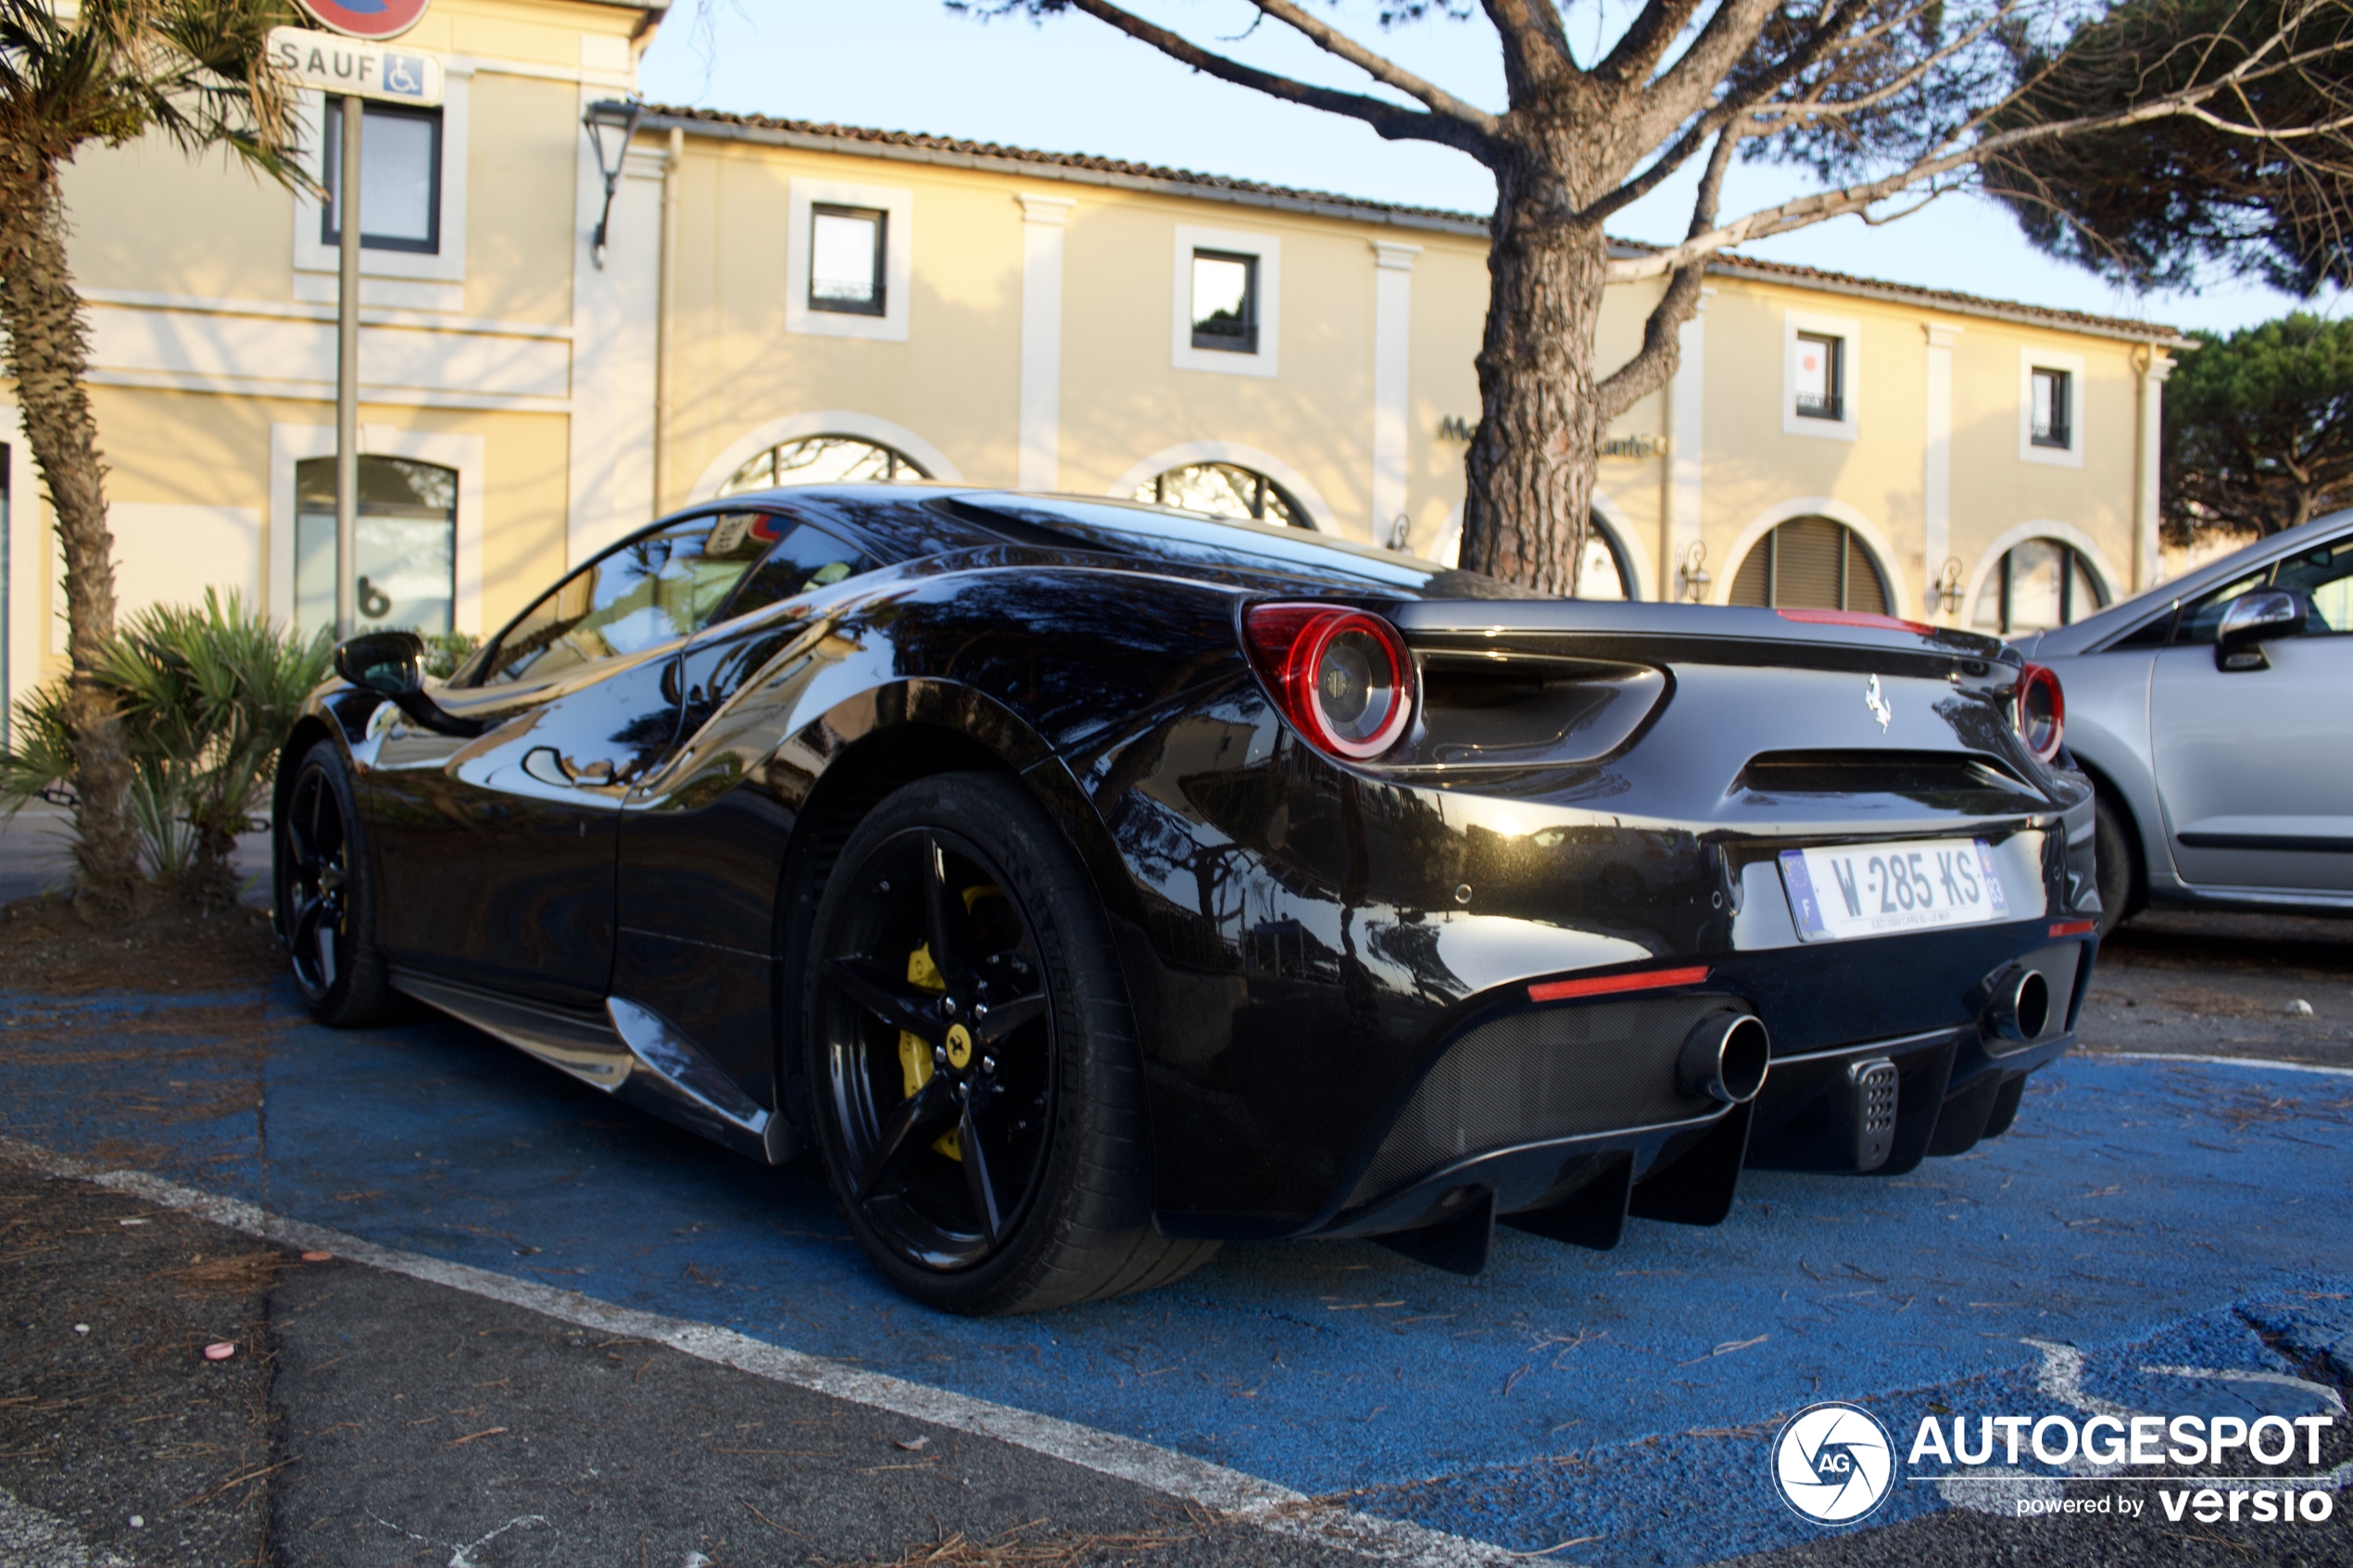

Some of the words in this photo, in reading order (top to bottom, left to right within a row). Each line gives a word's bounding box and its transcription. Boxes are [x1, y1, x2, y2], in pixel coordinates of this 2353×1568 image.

[281, 43, 374, 81] SAUF
[1987, 877, 2004, 904] 83
[1803, 898, 1810, 917] F
[1042, 930, 1079, 1093] MICHELIN
